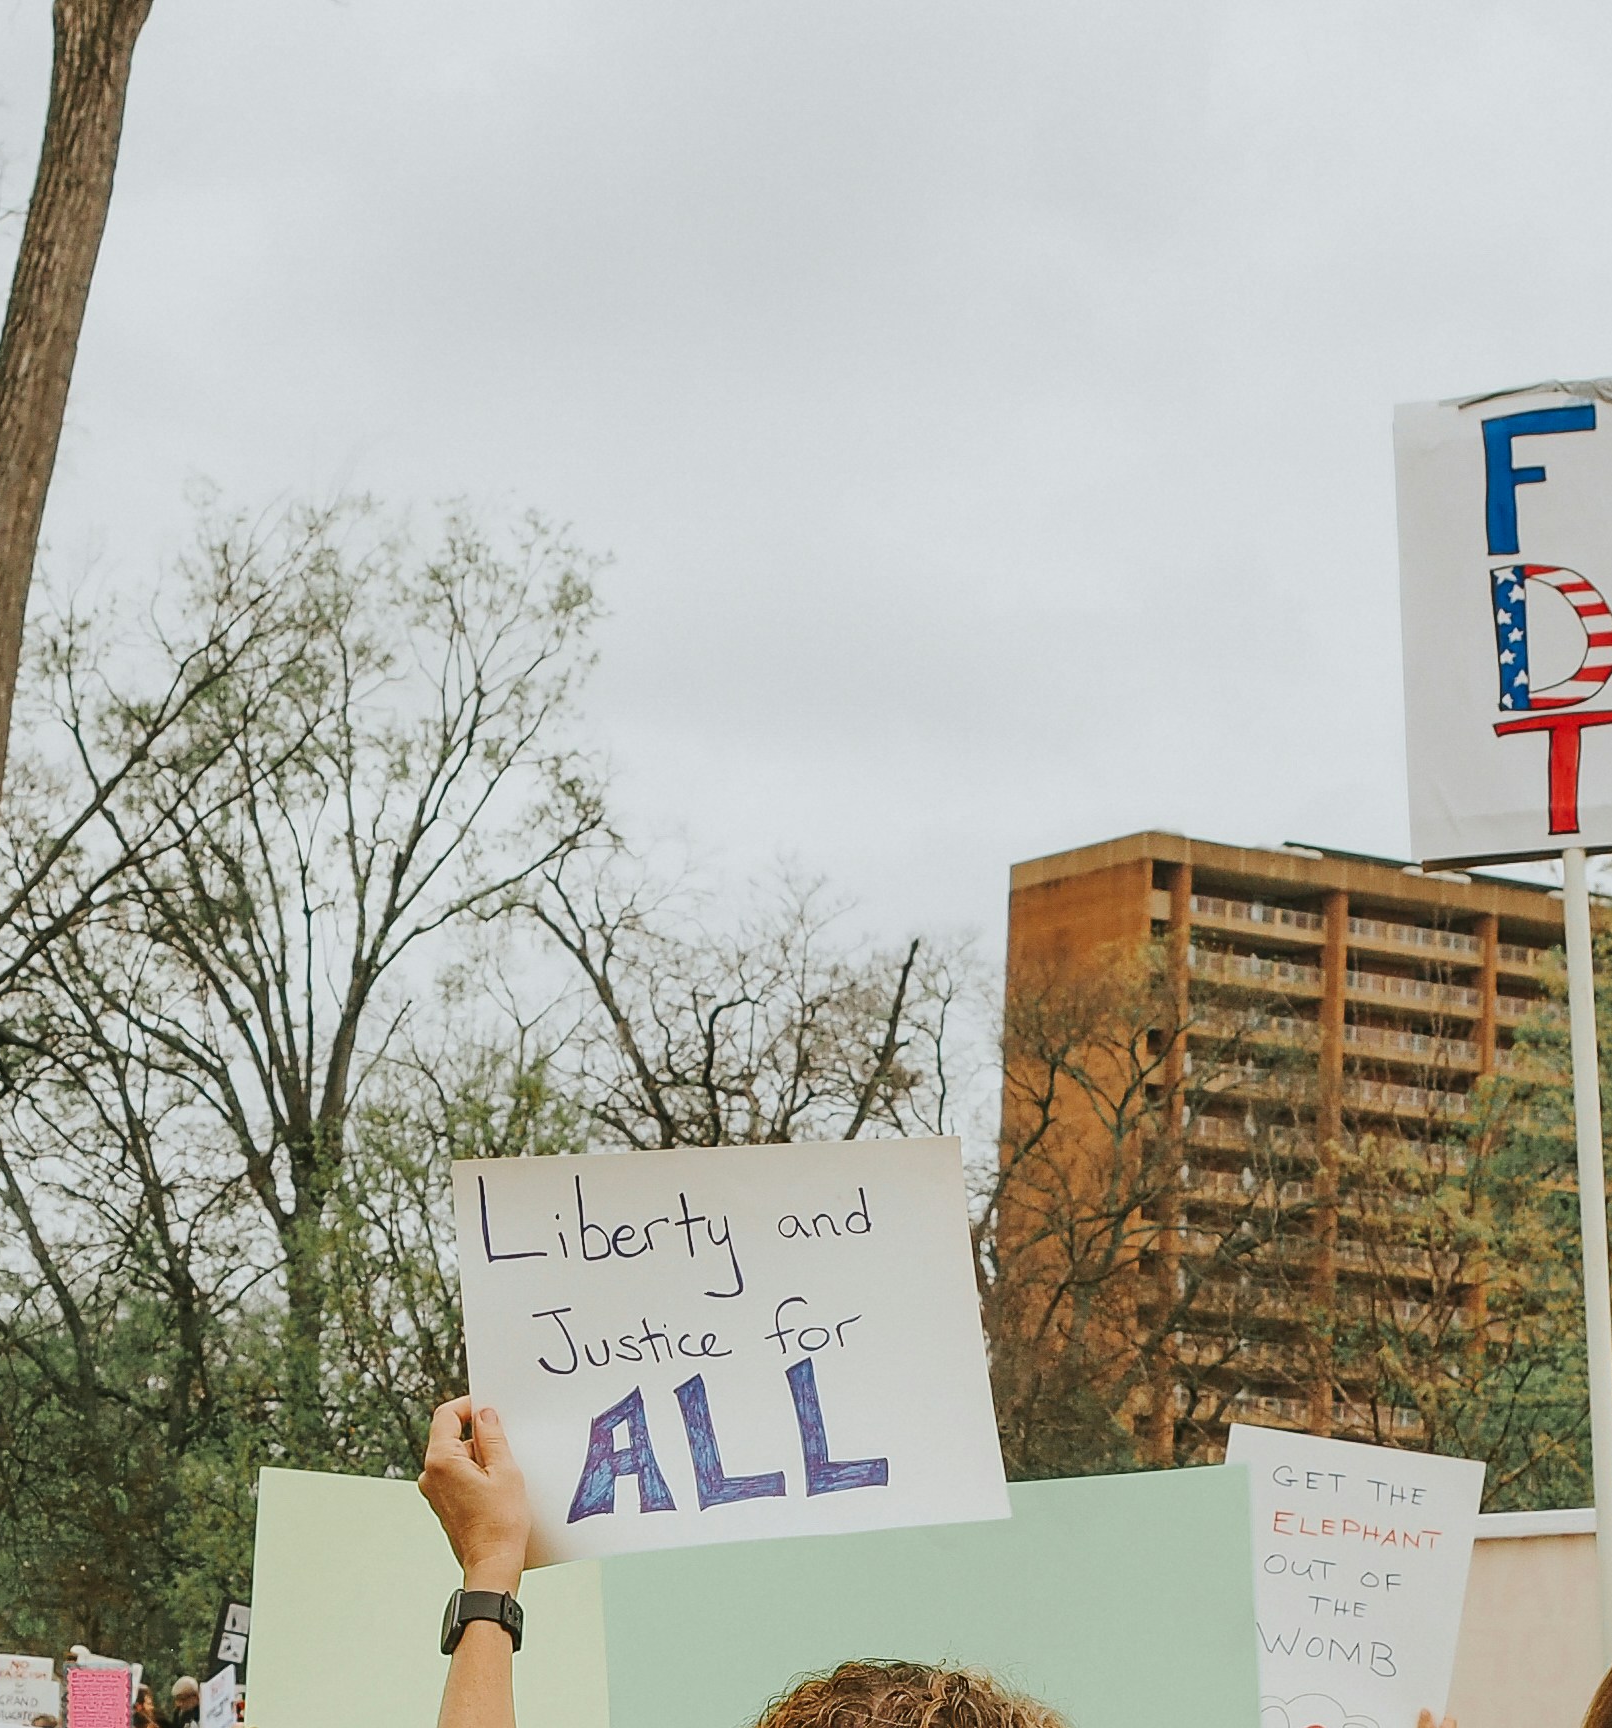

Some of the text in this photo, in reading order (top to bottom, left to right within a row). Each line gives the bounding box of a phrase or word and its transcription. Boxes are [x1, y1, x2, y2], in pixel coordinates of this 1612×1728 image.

[477, 1174, 873, 1298] Liberty and
[531, 1296, 863, 1375] Justice for
[566, 1356, 888, 1524] ALL
[1272, 1465, 1428, 1506] GET THE
[1273, 1510, 1443, 1551] ELEPHANT
[1264, 1553, 1403, 1593] OUT OF
[1308, 1595, 1368, 1619] THE
[1255, 1621, 1397, 1678] WOMB
